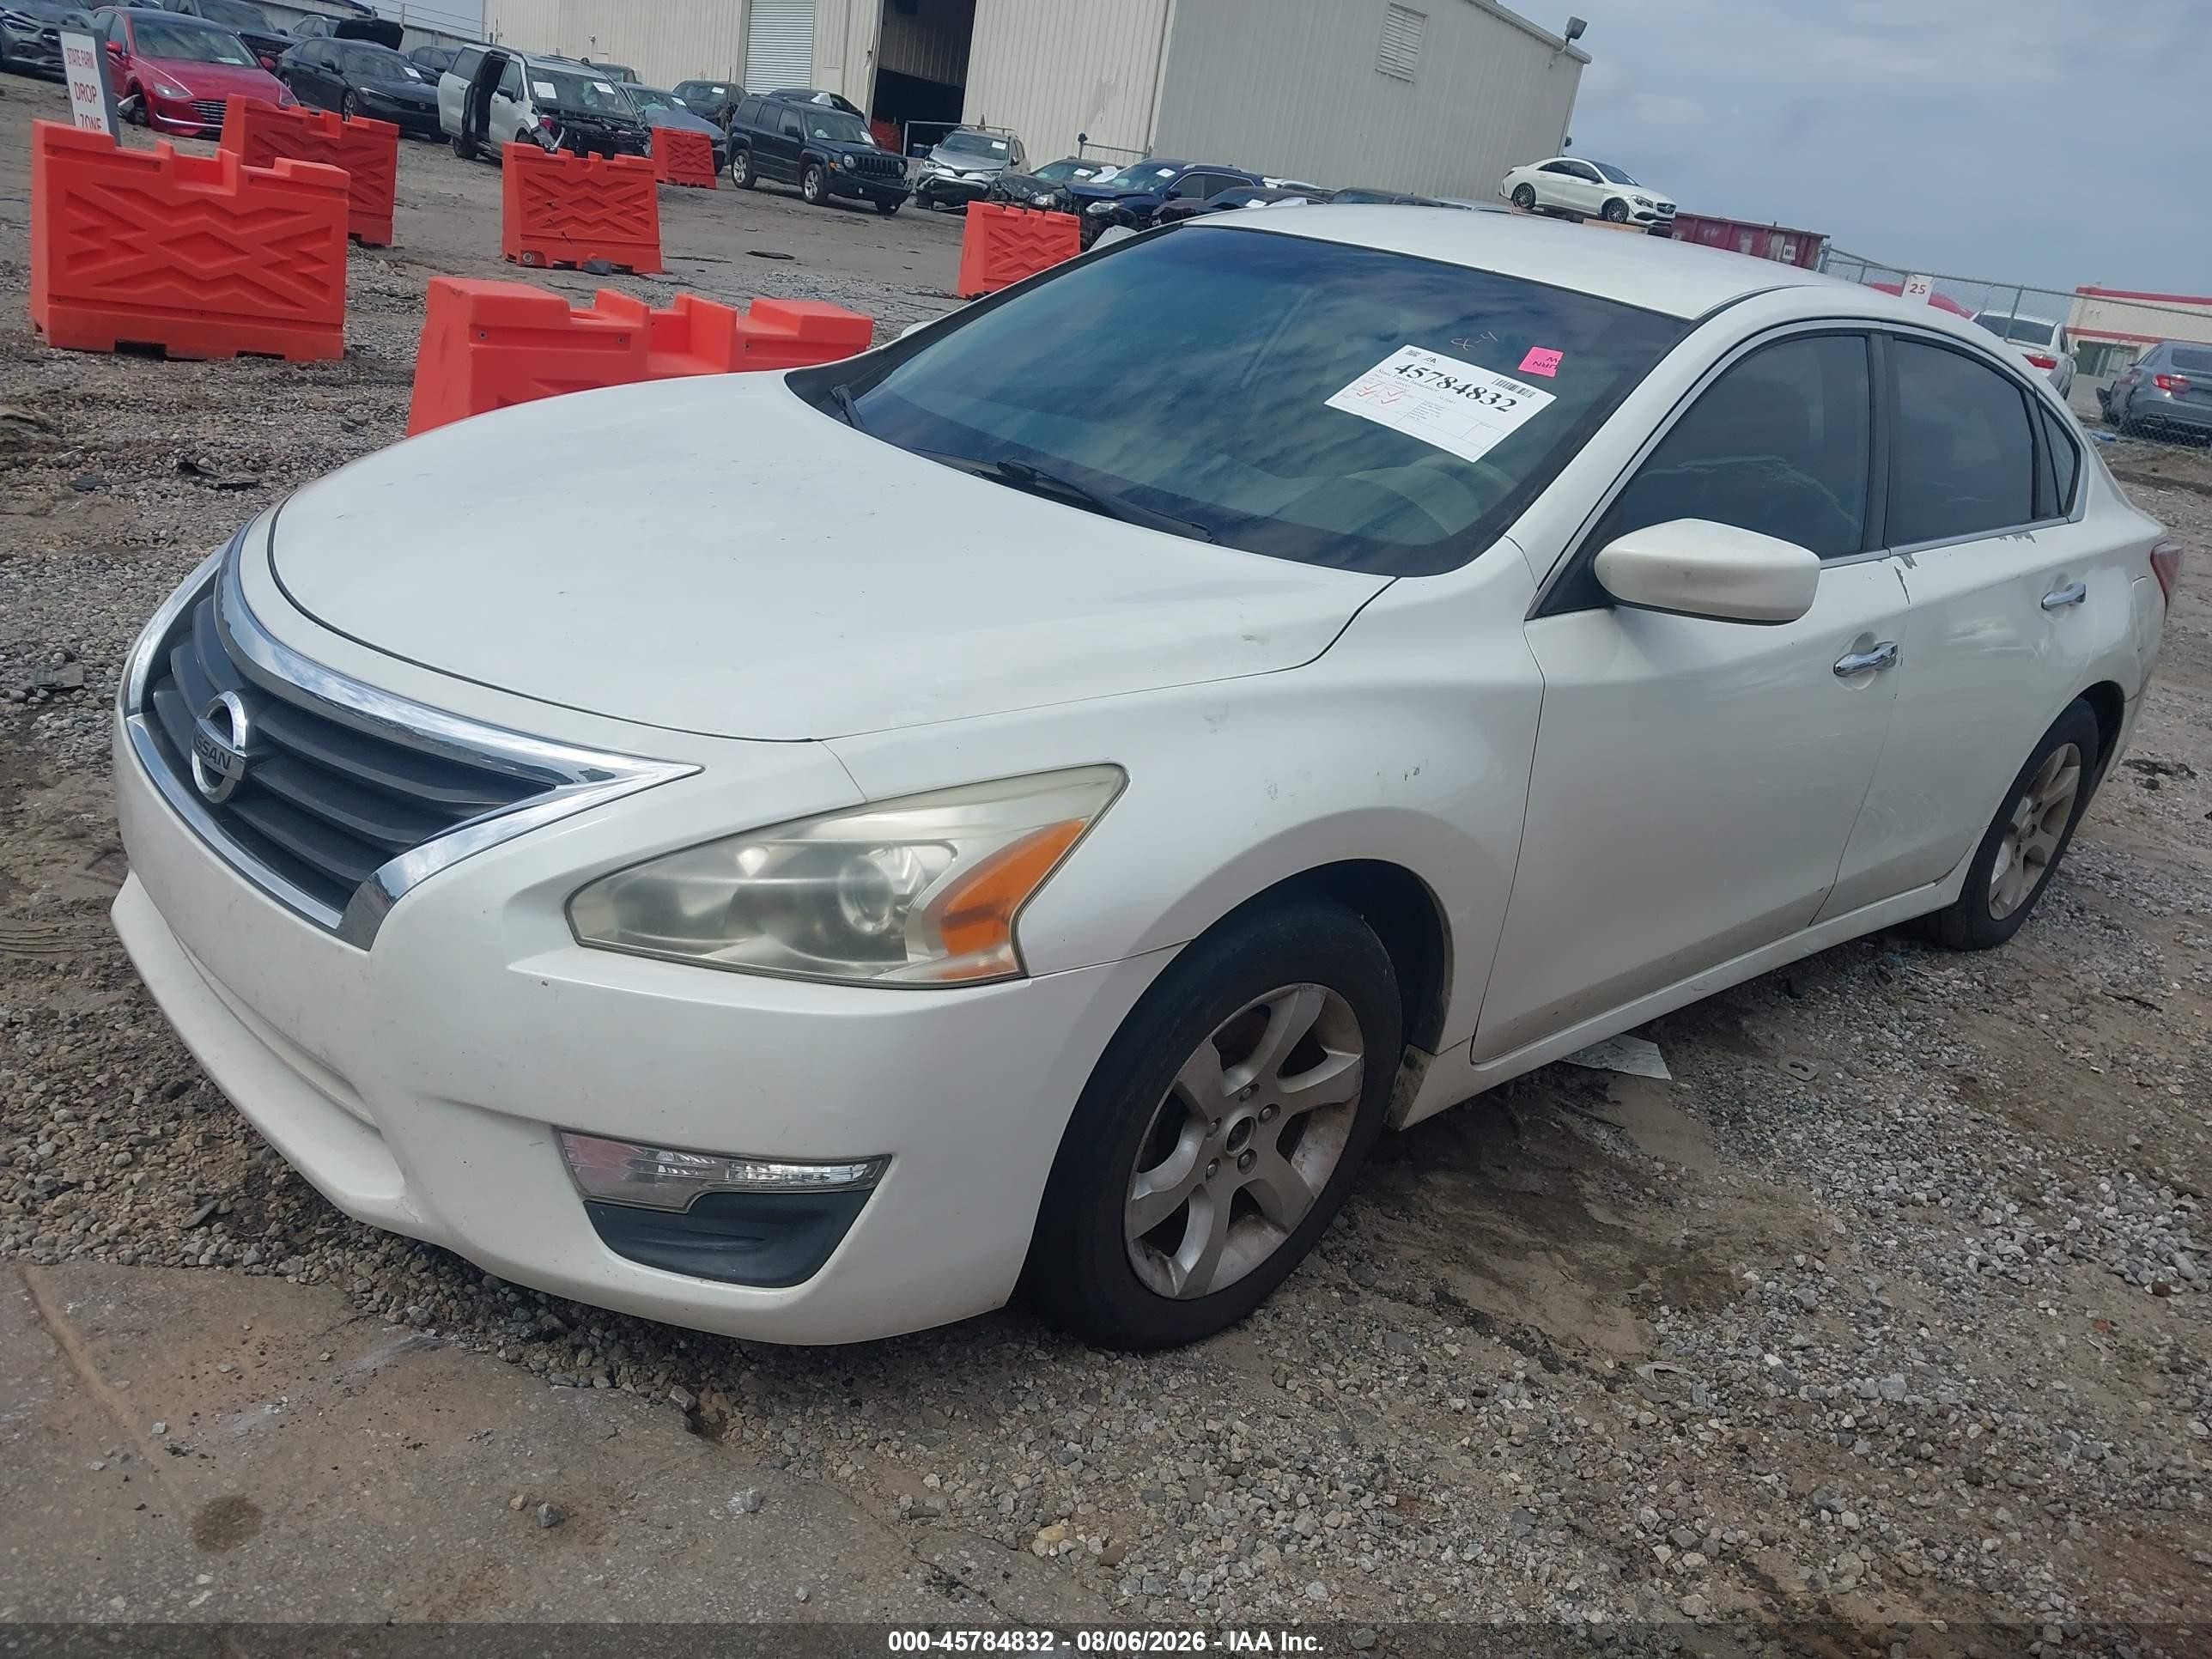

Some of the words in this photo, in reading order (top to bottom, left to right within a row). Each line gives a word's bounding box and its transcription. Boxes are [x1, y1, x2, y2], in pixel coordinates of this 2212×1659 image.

[74, 82, 97, 103] DROP
[1909, 283, 1927, 295] 25
[1394, 363, 1517, 413] 45784832
